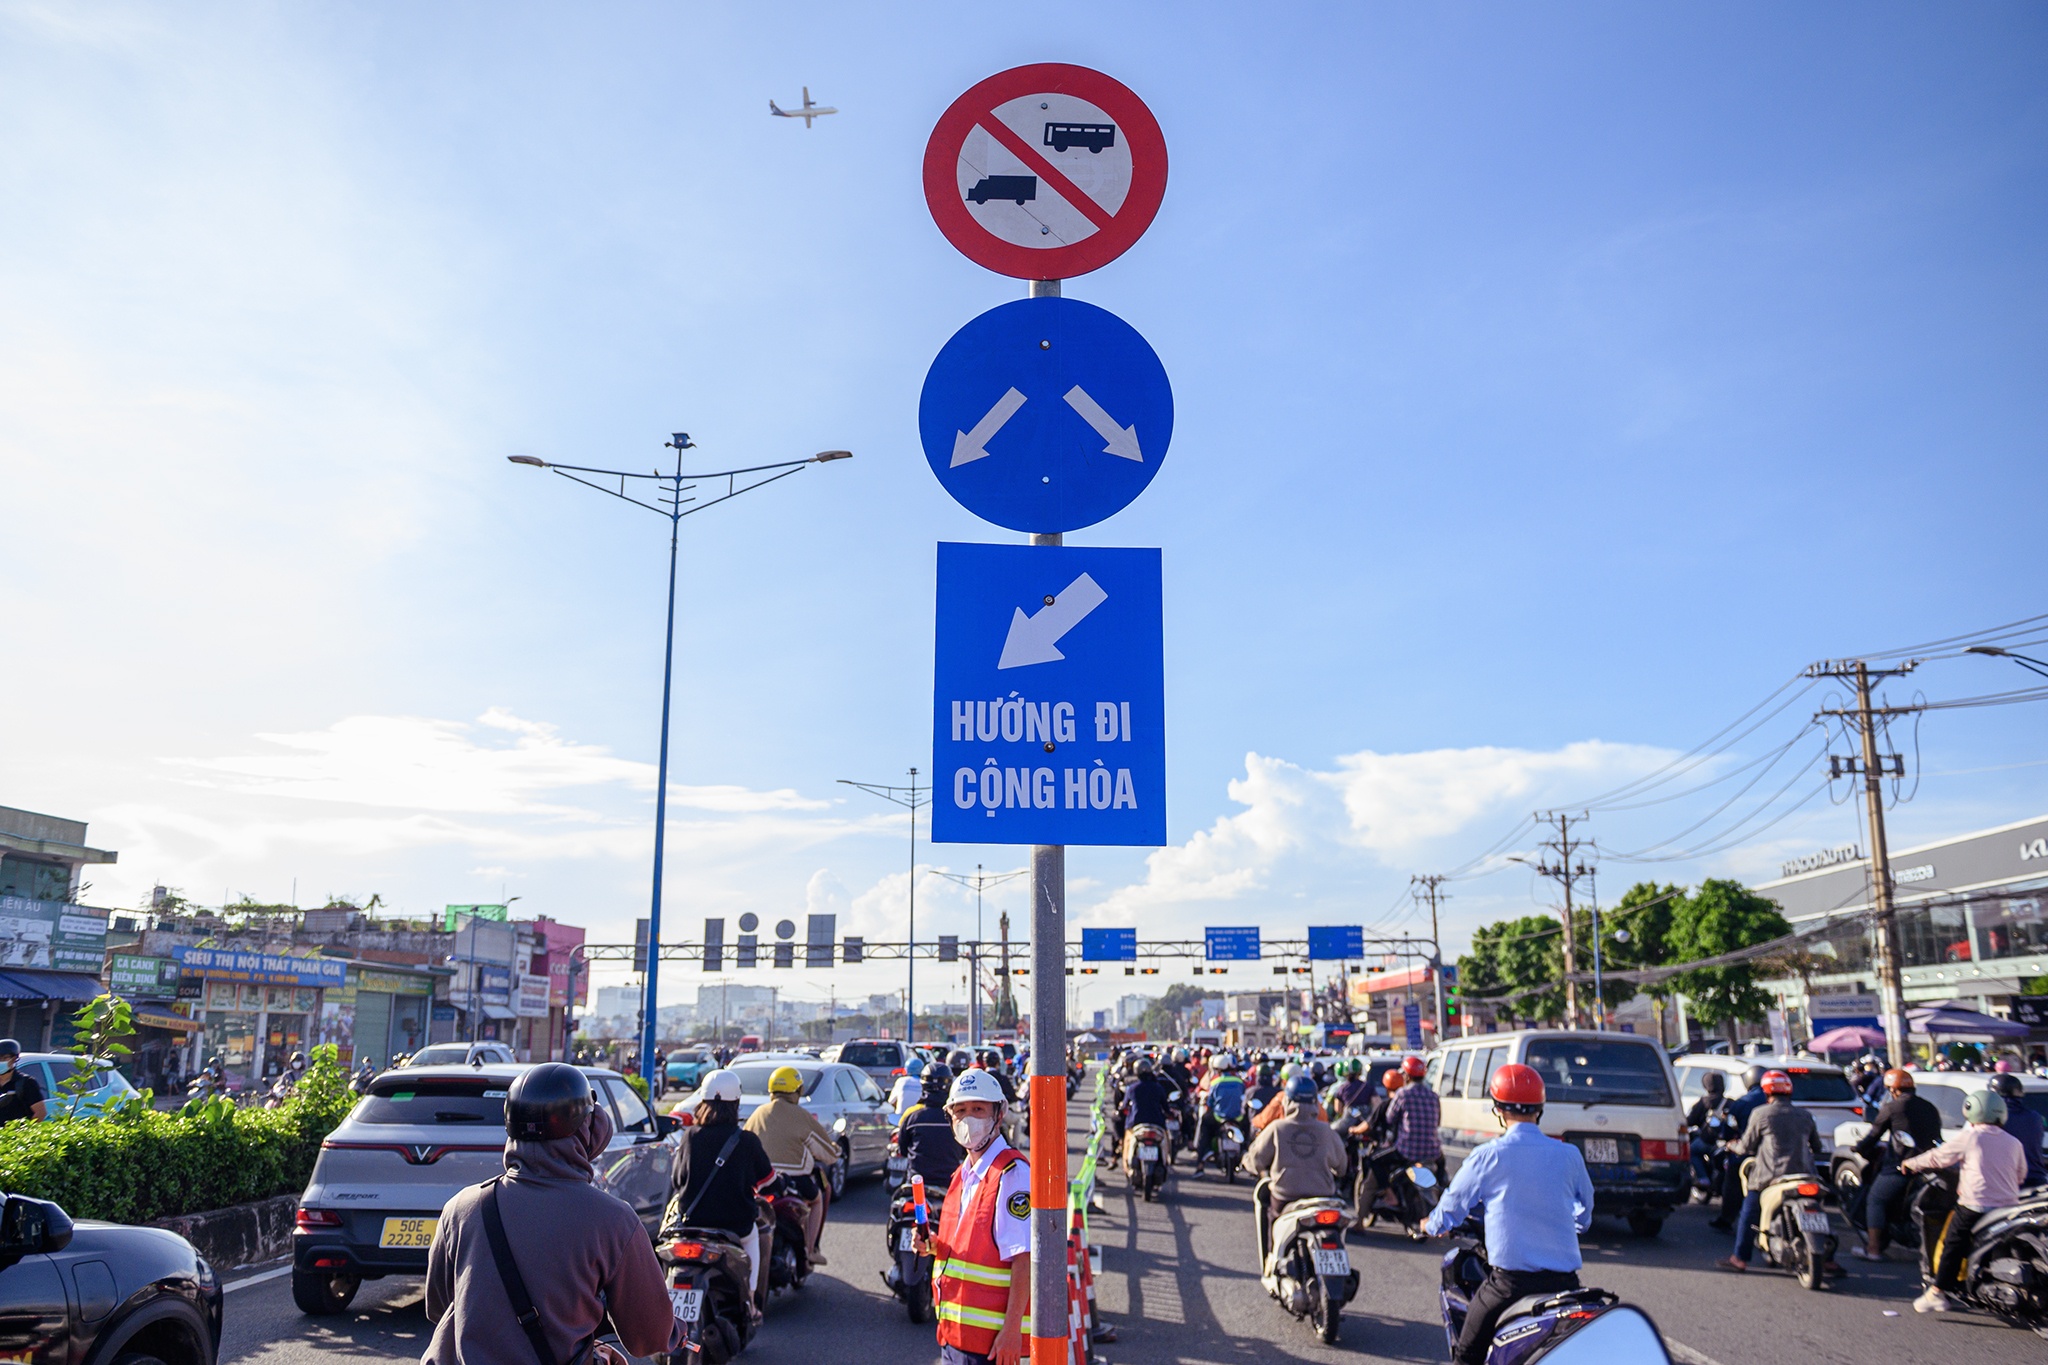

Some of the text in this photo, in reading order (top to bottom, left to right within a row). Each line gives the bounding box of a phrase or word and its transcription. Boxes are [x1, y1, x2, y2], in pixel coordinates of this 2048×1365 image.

[951, 690, 1132, 743] HƯỚNG ĐI
[953, 757, 1138, 818] CỘNG HÒA
[0, 897, 22, 910] IÊN
[183, 949, 213, 966] SIÊU
[215, 953, 235, 970] THỊ
[237, 955, 260, 972] NỘI
[322, 964, 341, 977] GIA
[180, 987, 200, 996] SOFA
[399, 1220, 425, 1233] 50E
[386, 1233, 432, 1246] 222.98
[668, 1292, 697, 1305] 7-AD
